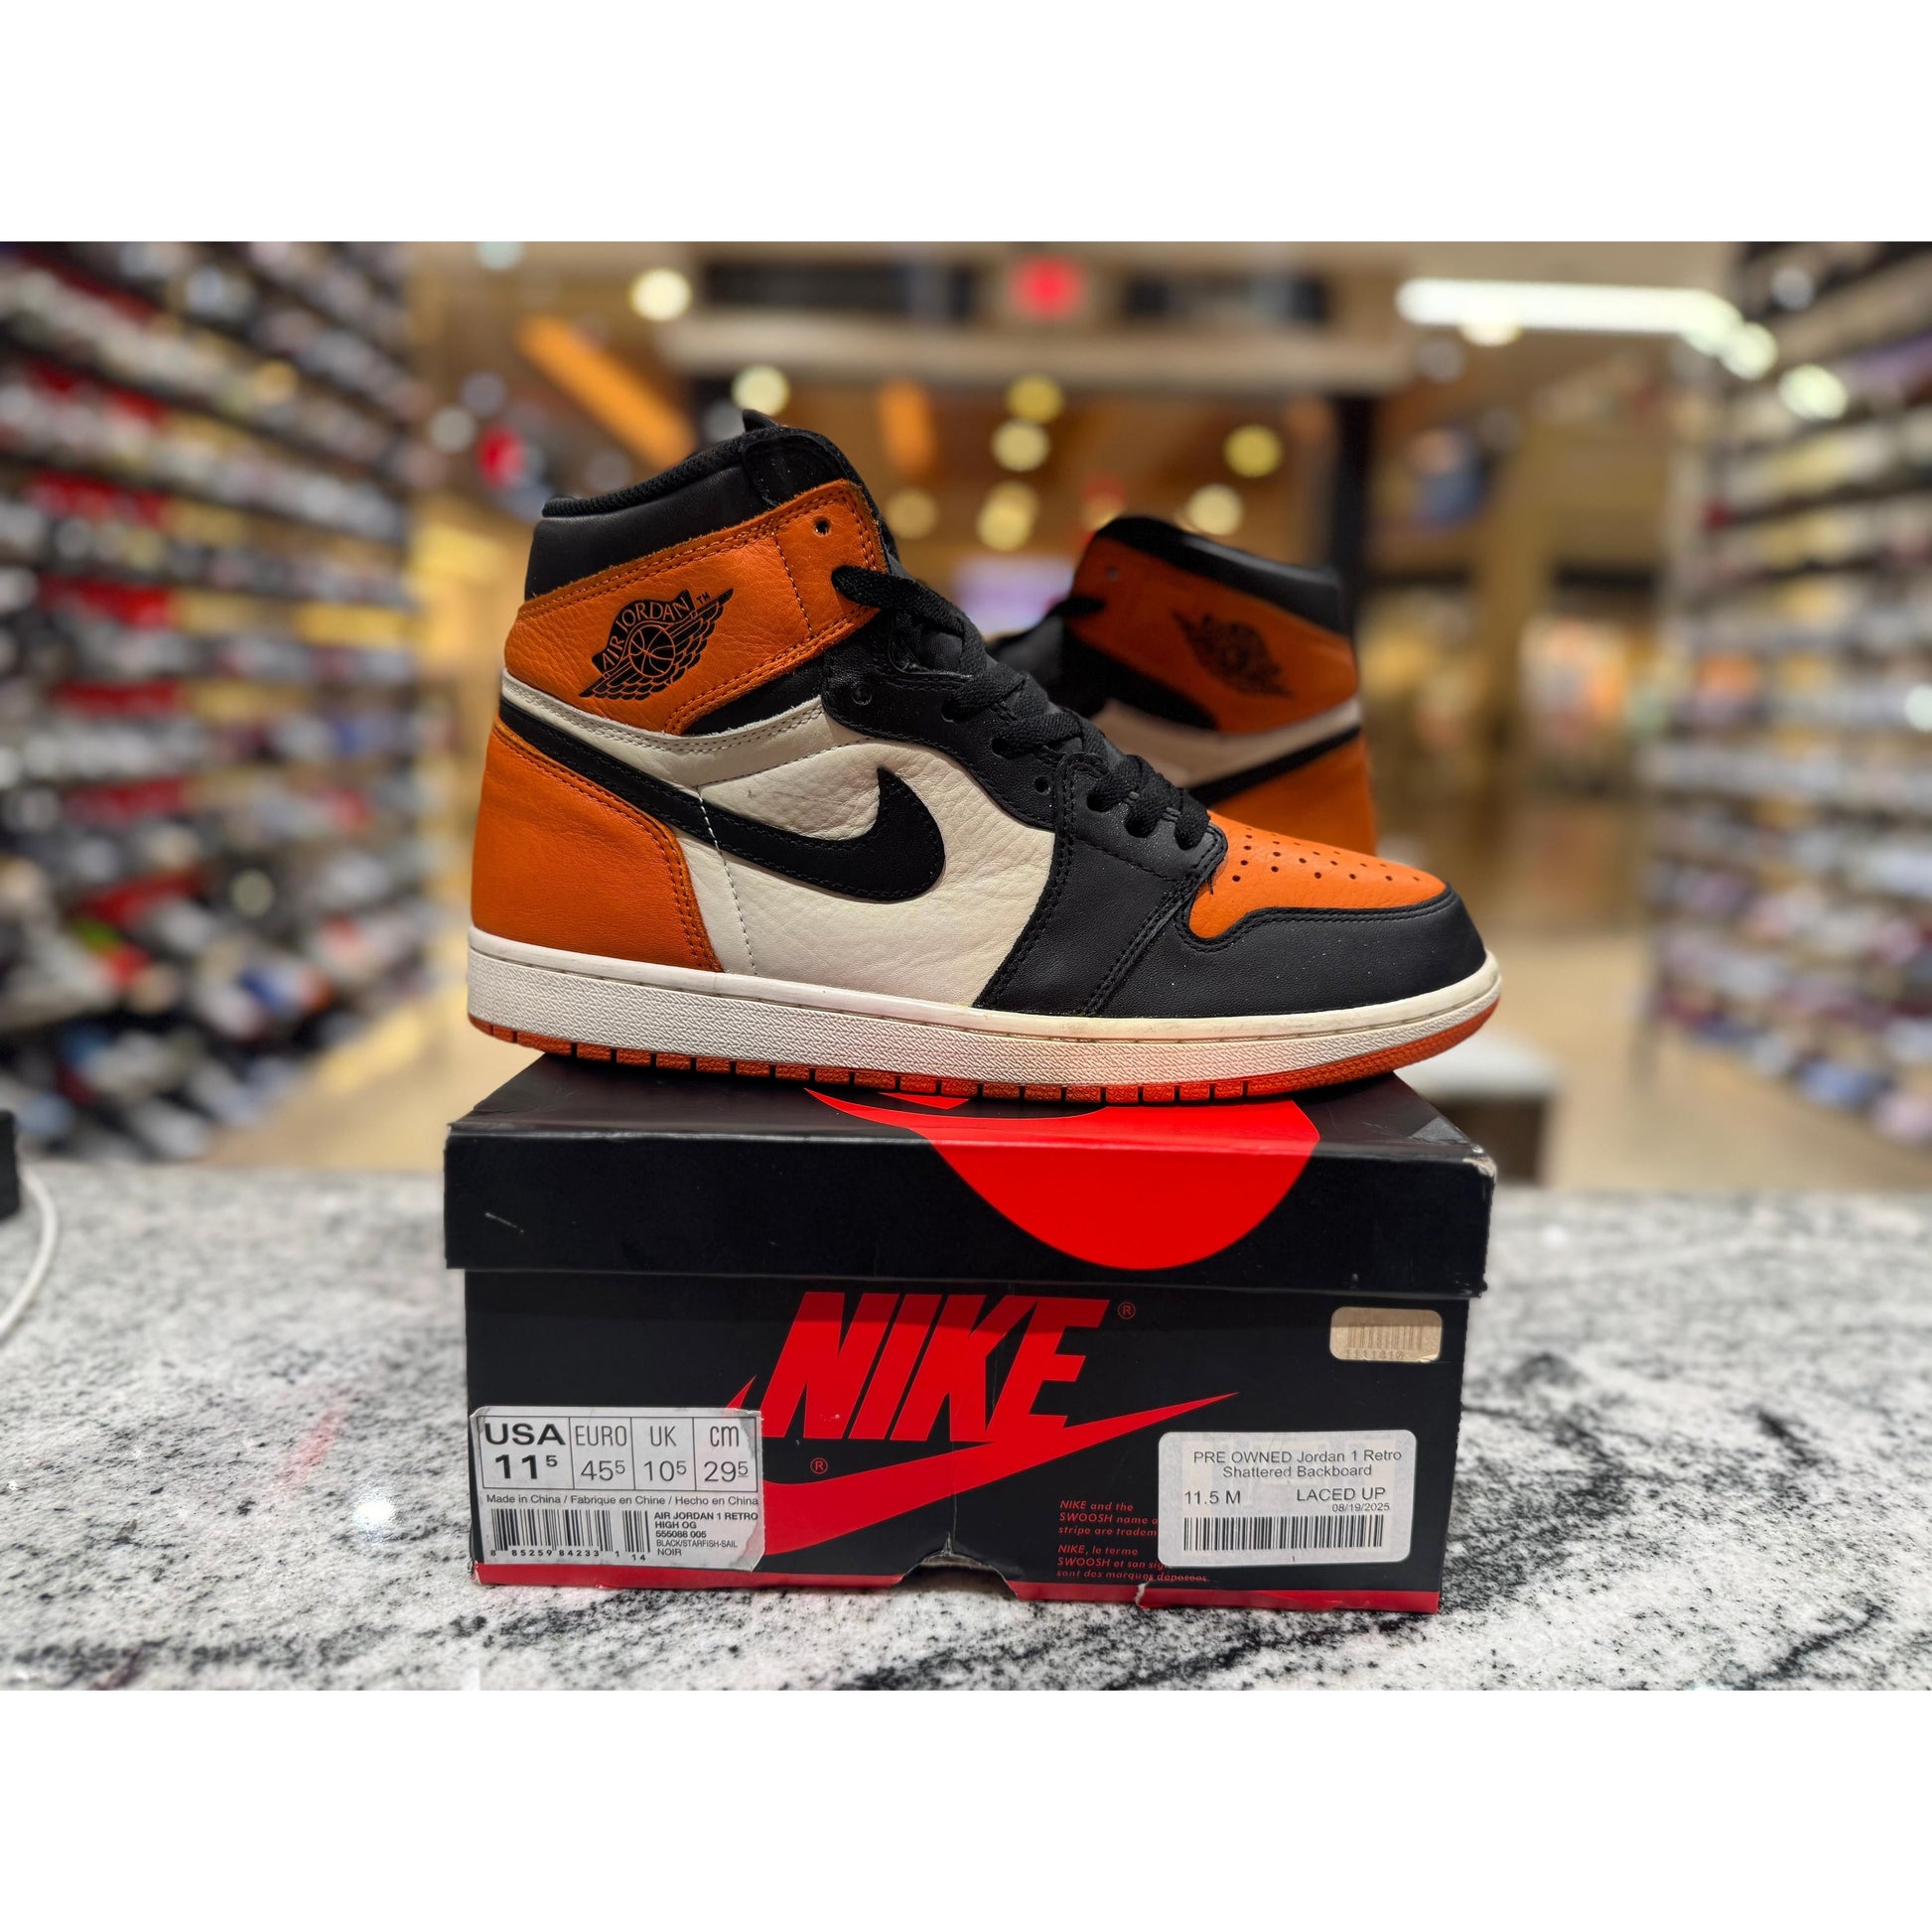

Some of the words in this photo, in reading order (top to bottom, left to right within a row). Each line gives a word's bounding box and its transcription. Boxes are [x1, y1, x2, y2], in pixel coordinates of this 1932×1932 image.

[601, 635, 625, 670] AIR
[616, 596, 691, 633] JORDAN
[760, 1292, 1110, 1443] NIKE
[484, 1423, 566, 1446] USA
[575, 1425, 627, 1447] EURO
[649, 1425, 677, 1447] UK
[710, 1426, 740, 1447] cm
[1193, 1450, 1226, 1463] PRE
[1231, 1450, 1293, 1463] OWNED
[1297, 1450, 1345, 1463] Jordan
[1350, 1449, 1357, 1461] 1
[1363, 1449, 1402, 1461] Retro
[1222, 1465, 1292, 1478] Shattered
[1297, 1463, 1372, 1477] Backboard
[486, 1493, 515, 1503] Made
[518, 1493, 528, 1503] in
[530, 1494, 561, 1504] China
[570, 1494, 617, 1506] Fabrique
[634, 1495, 666, 1505] Chine
[675, 1495, 709, 1505] Hecho
[728, 1495, 759, 1506] China
[1184, 1489, 1219, 1505] 11.5
[1225, 1490, 1241, 1504] M
[1297, 1487, 1356, 1501] LACED
[1361, 1487, 1387, 1501] UP
[1059, 1500, 1086, 1510] NIKE
[1090, 1501, 1113, 1511] and
[1115, 1502, 1134, 1512] the
[1331, 1502, 1391, 1512] 08/19/2025
[653, 1511, 671, 1520] AIR
[716, 1512, 722, 1521] 1
[725, 1512, 759, 1521] RETRO
[1058, 1512, 1113, 1523] SWOOSH
[1117, 1516, 1148, 1525] name
[1058, 1525, 1091, 1536] stripe
[1094, 1527, 1113, 1536] are
[1116, 1526, 1158, 1537] tradem
[656, 1539, 738, 1548] BLACK/STARFISH-SAIL
[1057, 1544, 1089, 1556] NIKE,
[1092, 1545, 1102, 1556] le
[1105, 1547, 1139, 1556] terme
[1057, 1557, 1111, 1568] SWOOSH
[1113, 1559, 1125, 1568] et
[1148, 1560, 1165, 1572] sig
[1056, 1569, 1081, 1579] sont
[1083, 1569, 1103, 1579] des
[1106, 1571, 1154, 1583] marques
